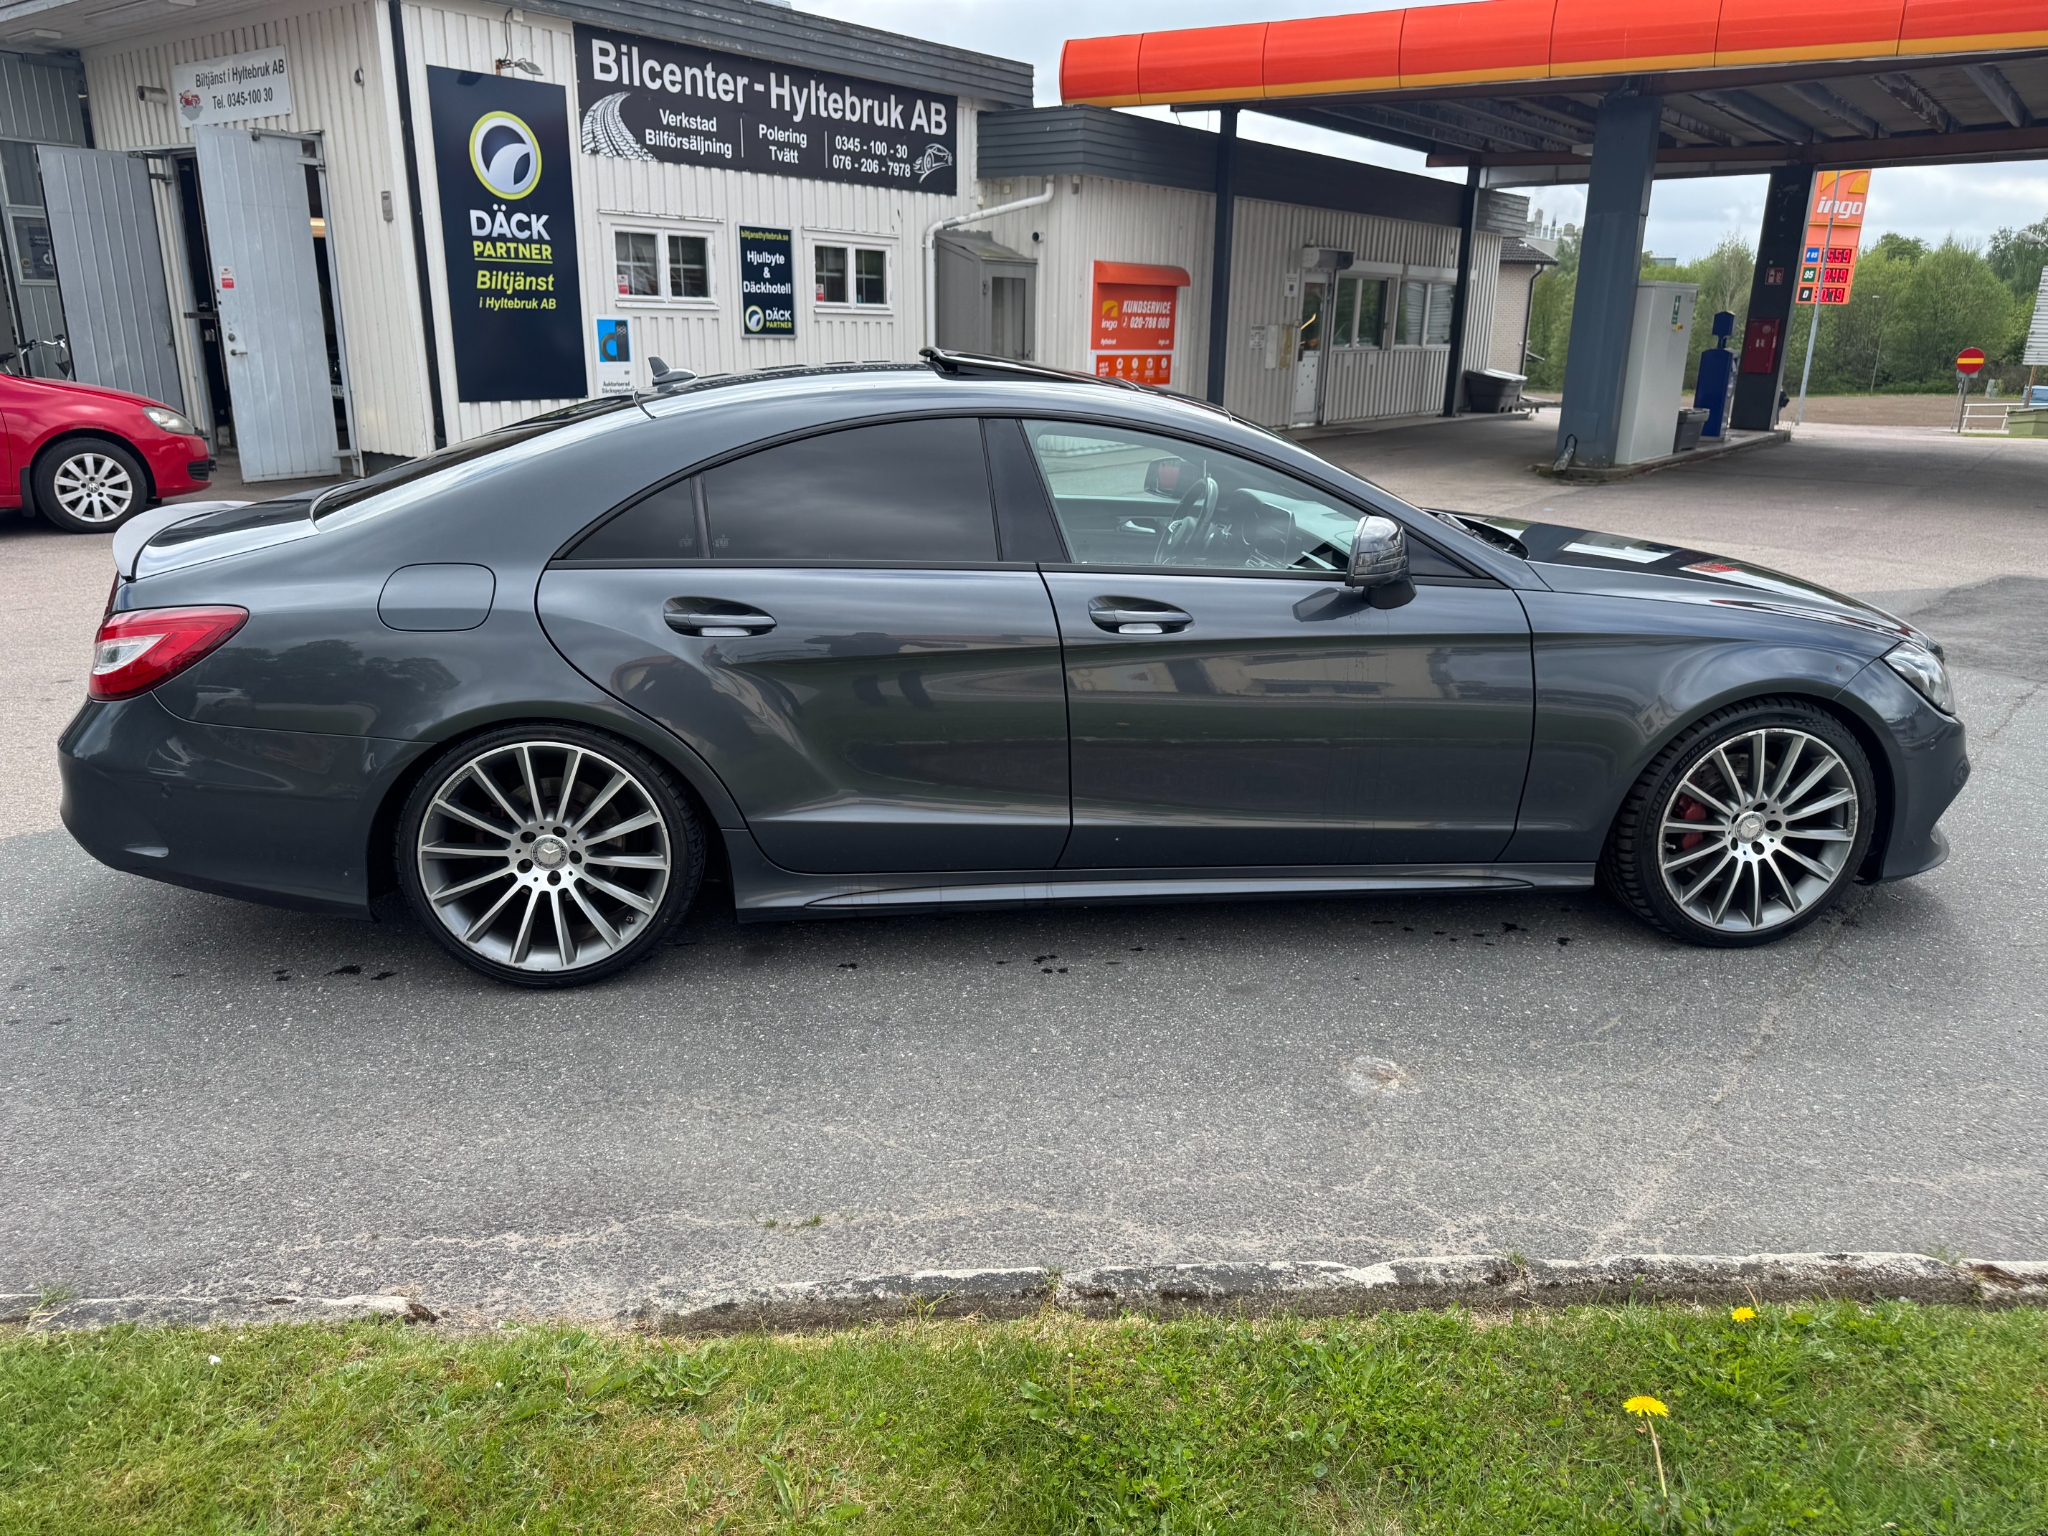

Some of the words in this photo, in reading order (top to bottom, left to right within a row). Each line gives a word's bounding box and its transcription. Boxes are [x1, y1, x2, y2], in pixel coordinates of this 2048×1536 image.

[195, 71, 227, 90] Biltjänst
[227, 68, 231, 83] i
[232, 61, 270, 84] Hyltebruk
[272, 58, 285, 75] AB
[591, 38, 749, 104] Bilcenter
[769, 72, 905, 129] Hyltebruk
[910, 99, 948, 136] AB
[212, 95, 226, 109] Tel.
[227, 88, 261, 107] 0345-100
[263, 87, 273, 102] 30
[659, 108, 717, 132] Verkstad
[645, 128, 732, 159] Bilförsäljning
[758, 123, 807, 148] Polering
[768, 146, 799, 164] Tvätt
[835, 135, 861, 152] 0345
[869, 140, 887, 156] 100
[896, 145, 908, 159] 30
[832, 154, 852, 170] 076
[860, 158, 879, 174] 206
[887, 161, 911, 178] 7978
[1816, 196, 1863, 219] ingo
[469, 203, 551, 240] DÄCK
[473, 240, 552, 260] PARTNER
[746, 250, 785, 266] Hjulbyte
[763, 266, 771, 278] &
[1803, 270, 1814, 279] 95
[476, 270, 555, 295] Biltjänst
[743, 281, 791, 294] Däckhotell
[1802, 289, 1809, 298] D
[479, 297, 483, 308] i
[485, 297, 538, 312] Hyltebruk
[540, 298, 557, 309] AB
[765, 307, 791, 320] DÄCK
[1122, 300, 1171, 314] KUNDSERVICE
[766, 321, 792, 329] PARTNER
[1101, 318, 1118, 331] ingo
